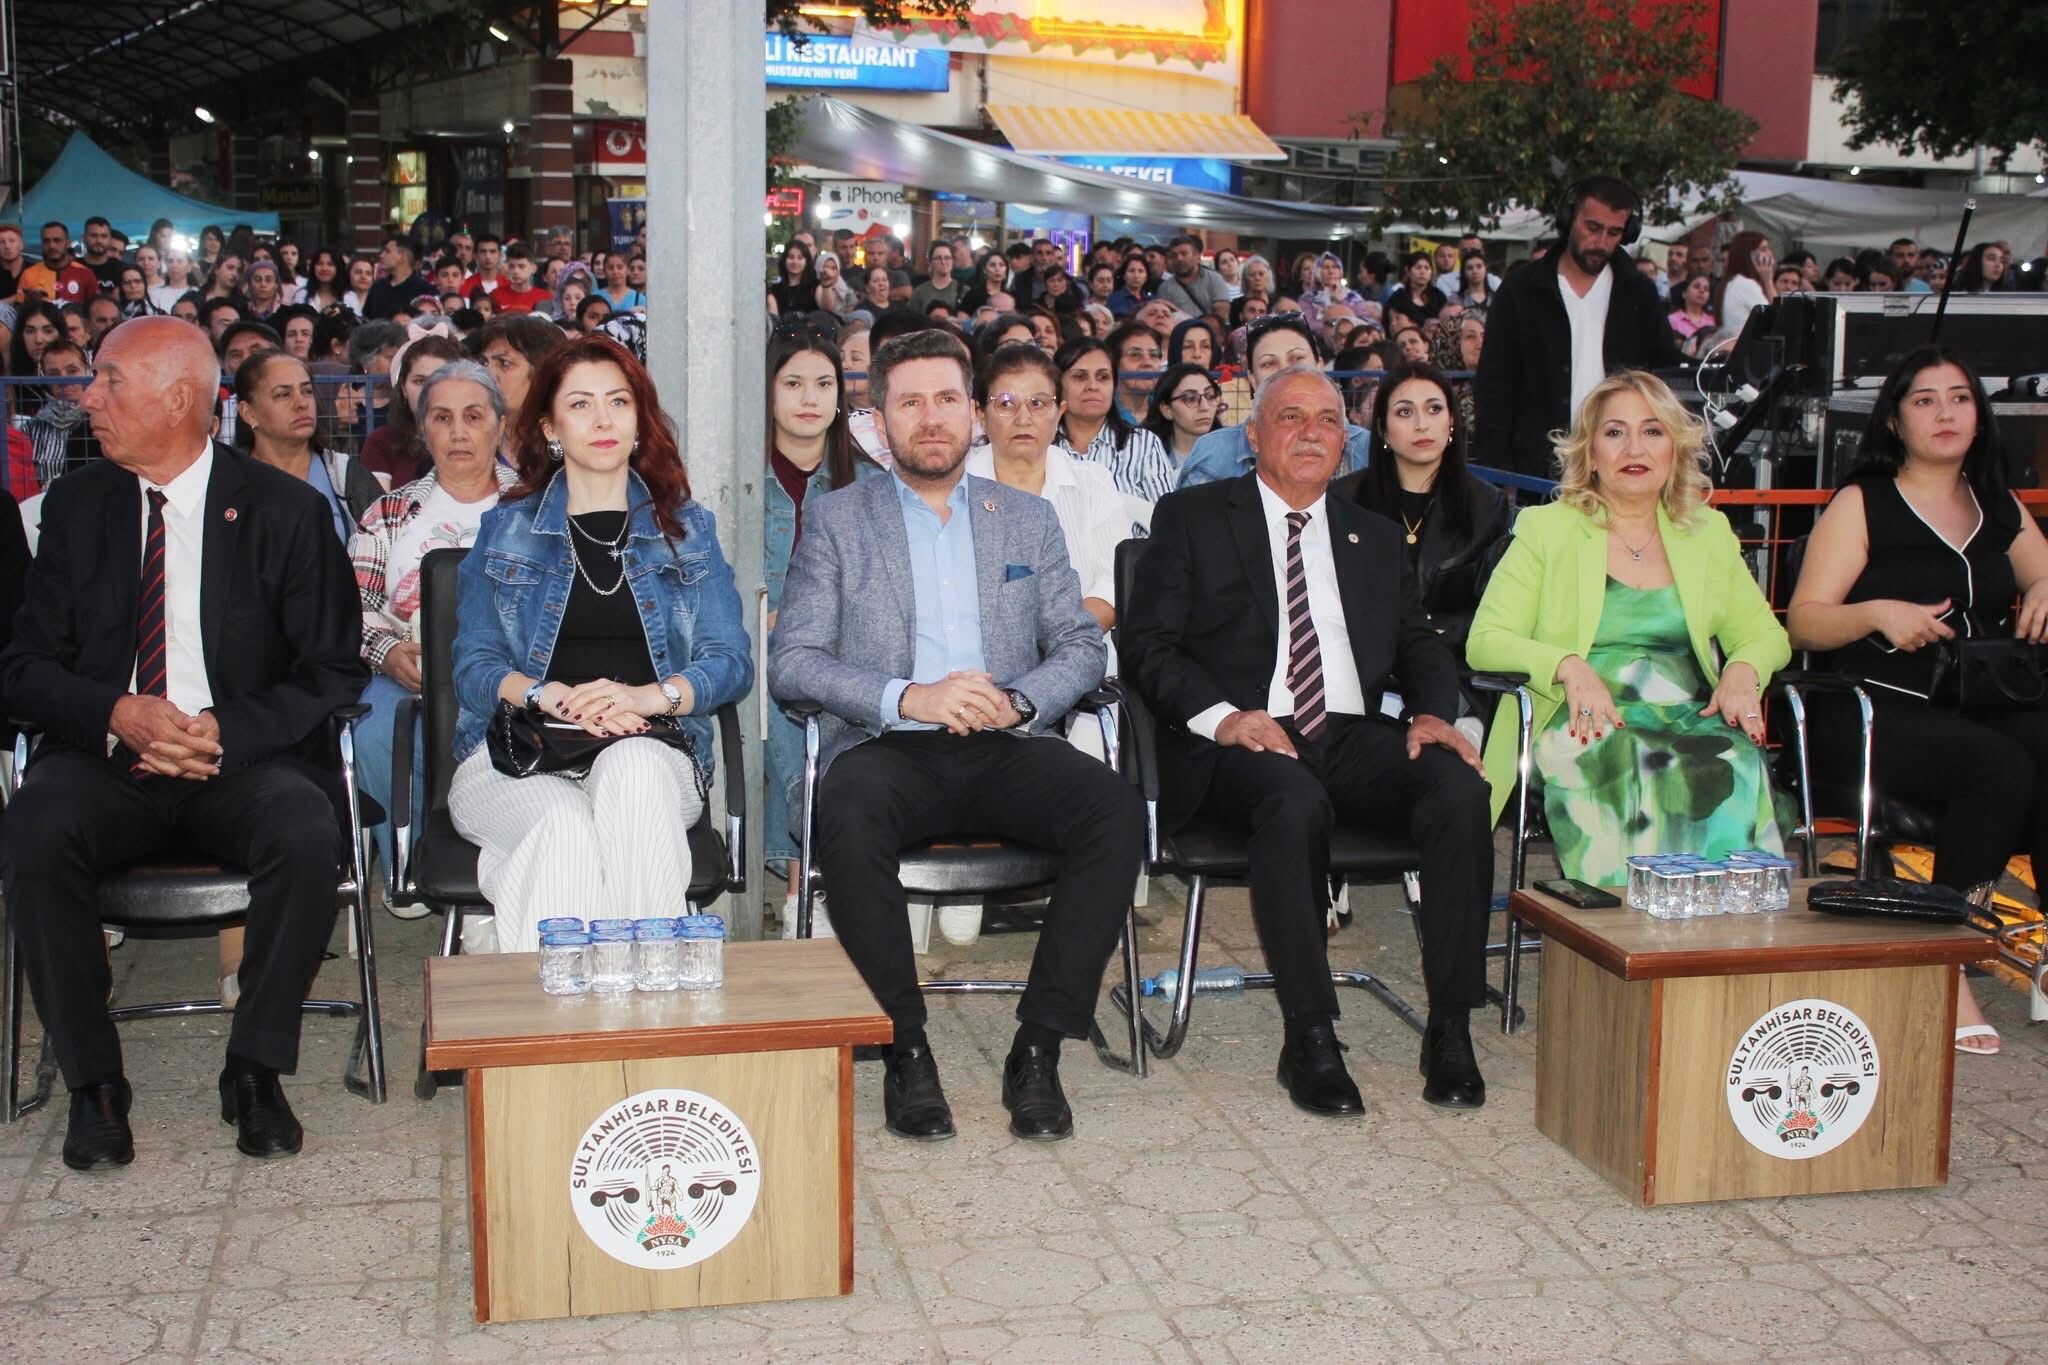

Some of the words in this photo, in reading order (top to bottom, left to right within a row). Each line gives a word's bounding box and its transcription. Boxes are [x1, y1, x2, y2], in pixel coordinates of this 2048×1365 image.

[786, 41, 918, 68] RESTAURANT
[834, 67, 858, 80] YERİ
[847, 187, 903, 203] iPhone
[1730, 1008, 1812, 1085] SULTANHİSAR
[1817, 1009, 1877, 1076] BELEDİYESİ
[573, 1099, 668, 1189] SULTANHİSAR
[675, 1099, 757, 1175] BELEDİYESİ
[650, 1236, 683, 1248] NYSA
[656, 1249, 676, 1257] 1924
